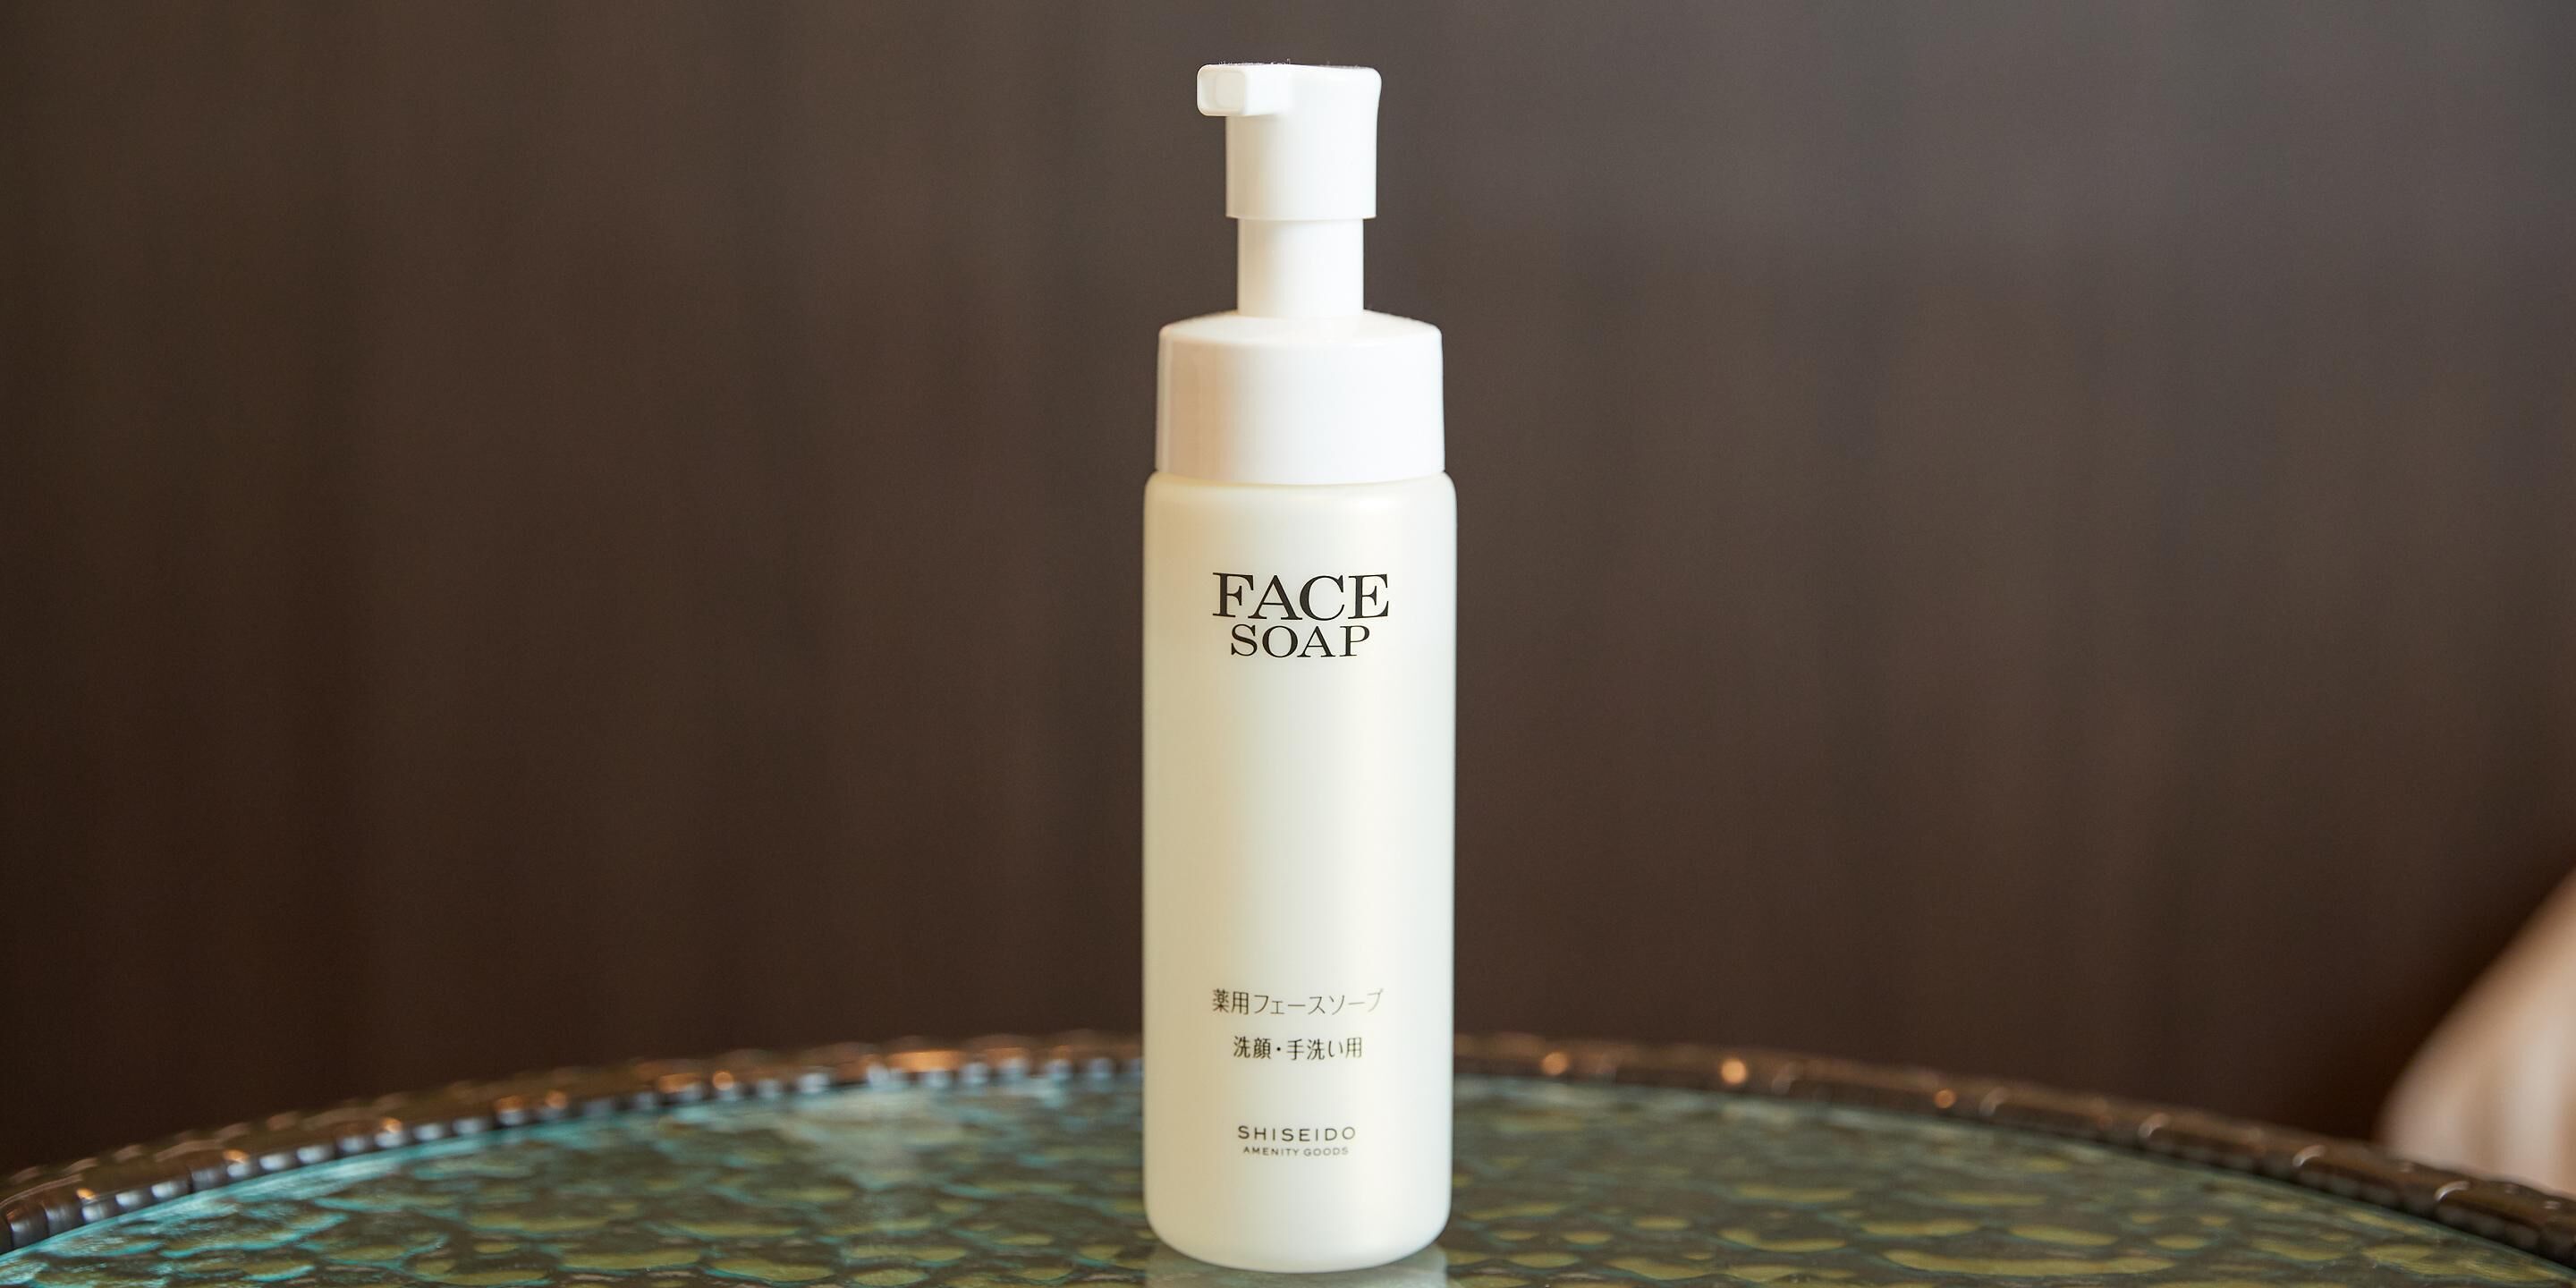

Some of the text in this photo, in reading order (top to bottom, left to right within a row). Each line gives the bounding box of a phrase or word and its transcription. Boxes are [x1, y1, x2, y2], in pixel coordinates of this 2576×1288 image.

[1212, 572, 1389, 621] FACE
[1231, 623, 1370, 657] SOAP
[1212, 987, 1384, 1015] 薬用フェースソープ
[1233, 1035, 1362, 1061] 洗顔・手洗い用
[1237, 1125, 1356, 1142] SHISEIDO
[1243, 1146, 1349, 1157] AMENITY GOODS
